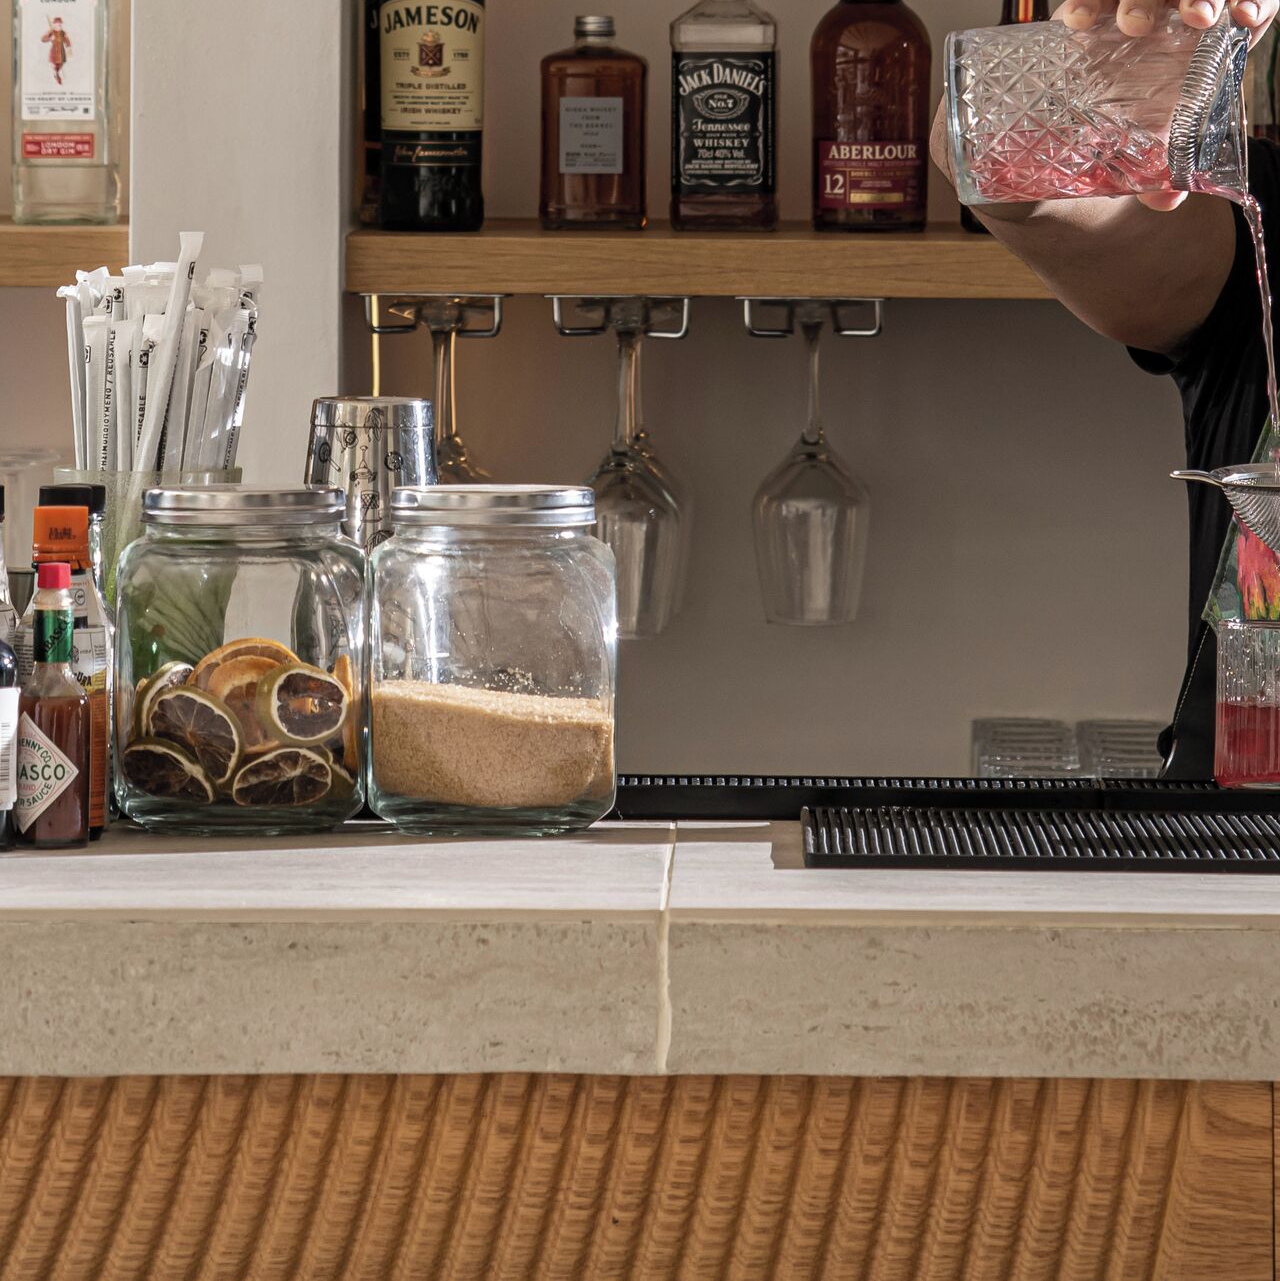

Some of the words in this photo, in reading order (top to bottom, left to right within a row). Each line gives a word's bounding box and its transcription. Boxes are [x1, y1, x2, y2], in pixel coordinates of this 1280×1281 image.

[384, 5, 480, 34] JAMESON
[678, 68, 712, 96] JACK
[713, 63, 767, 96] DANIEL'S
[692, 119, 751, 131] Tennessee
[693, 139, 750, 147] WHISKEY
[829, 144, 918, 159] ABERLOUR
[824, 173, 845, 194] 12
[17, 763, 66, 781] ASCO
